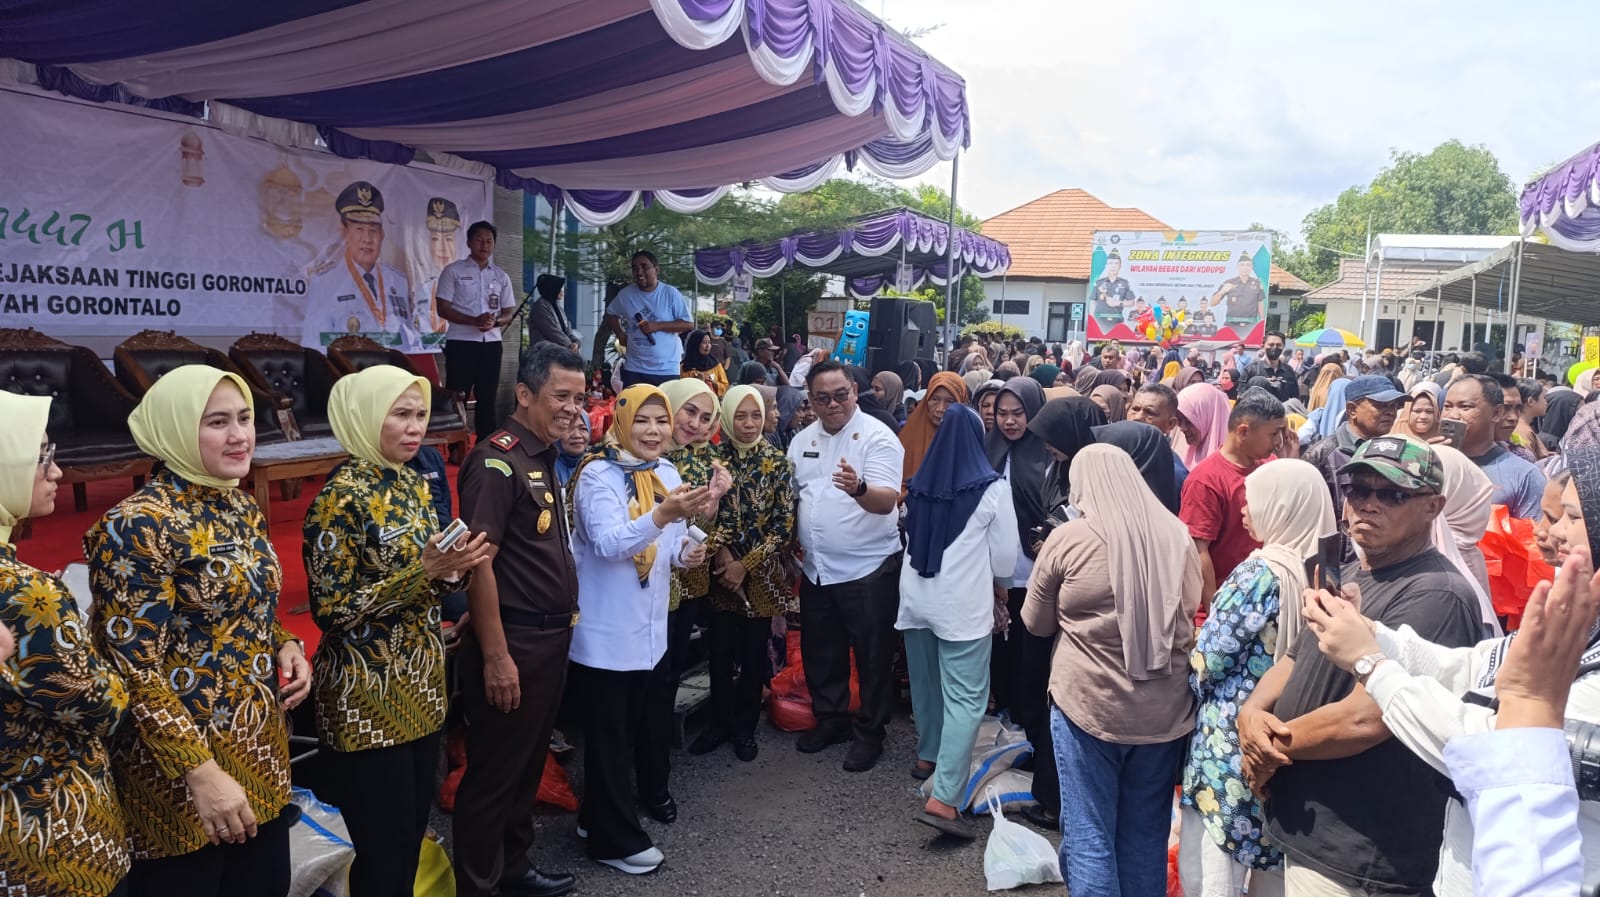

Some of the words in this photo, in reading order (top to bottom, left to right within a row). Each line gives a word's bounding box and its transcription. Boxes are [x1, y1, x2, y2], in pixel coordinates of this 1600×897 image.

[1128, 250, 1160, 261] ZONA
[1162, 250, 1231, 261] INTEGRITAS
[1158, 265, 1179, 273] BEBAS
[1180, 265, 1196, 273] DARI
[126, 270, 195, 290] TINGGI
[202, 274, 306, 295] GORONTALO
[47, 295, 181, 316] GORONTALO
